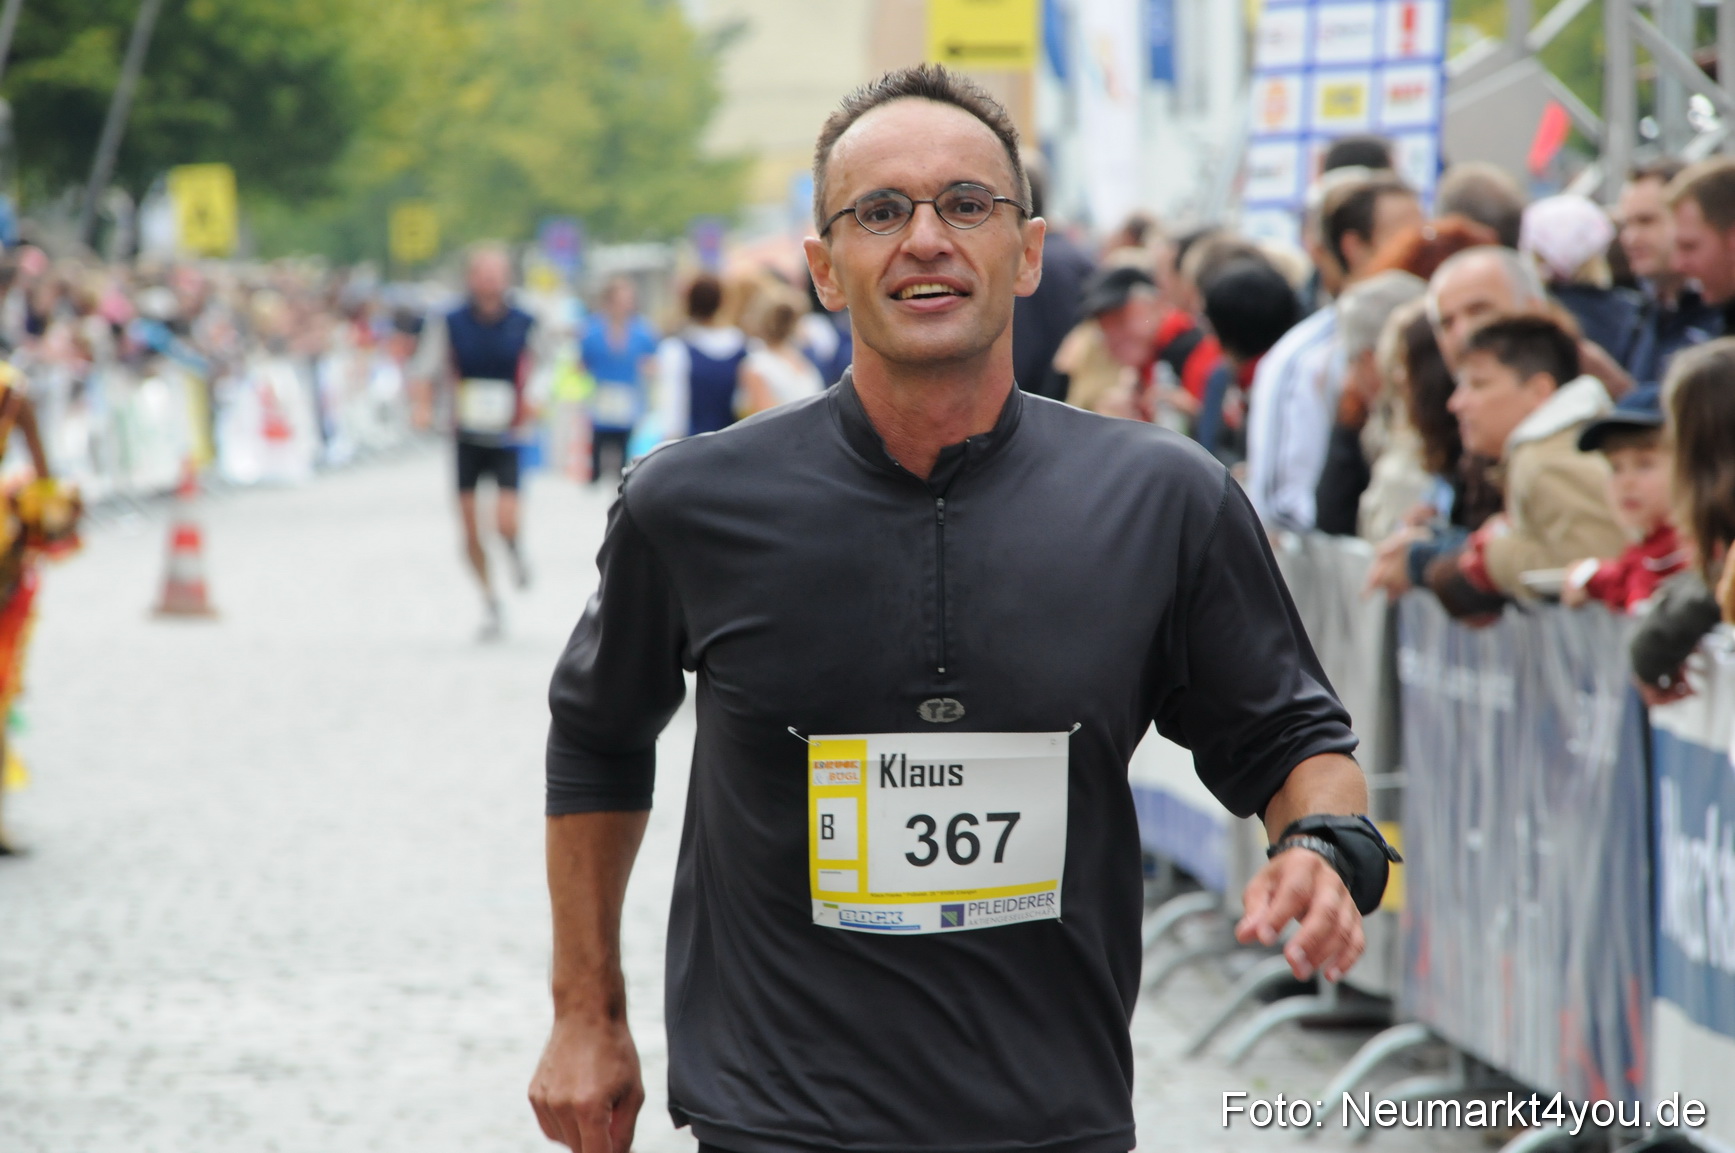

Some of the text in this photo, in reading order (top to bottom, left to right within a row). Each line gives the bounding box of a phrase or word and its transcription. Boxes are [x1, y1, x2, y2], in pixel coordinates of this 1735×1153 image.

[927, 702, 957, 719] T2
[880, 753, 963, 788] Klaus
[821, 814, 834, 840] B
[905, 812, 1021, 867] 367
[839, 909, 903, 924] BOCK
[968, 892, 1056, 916] PFLEIDERER
